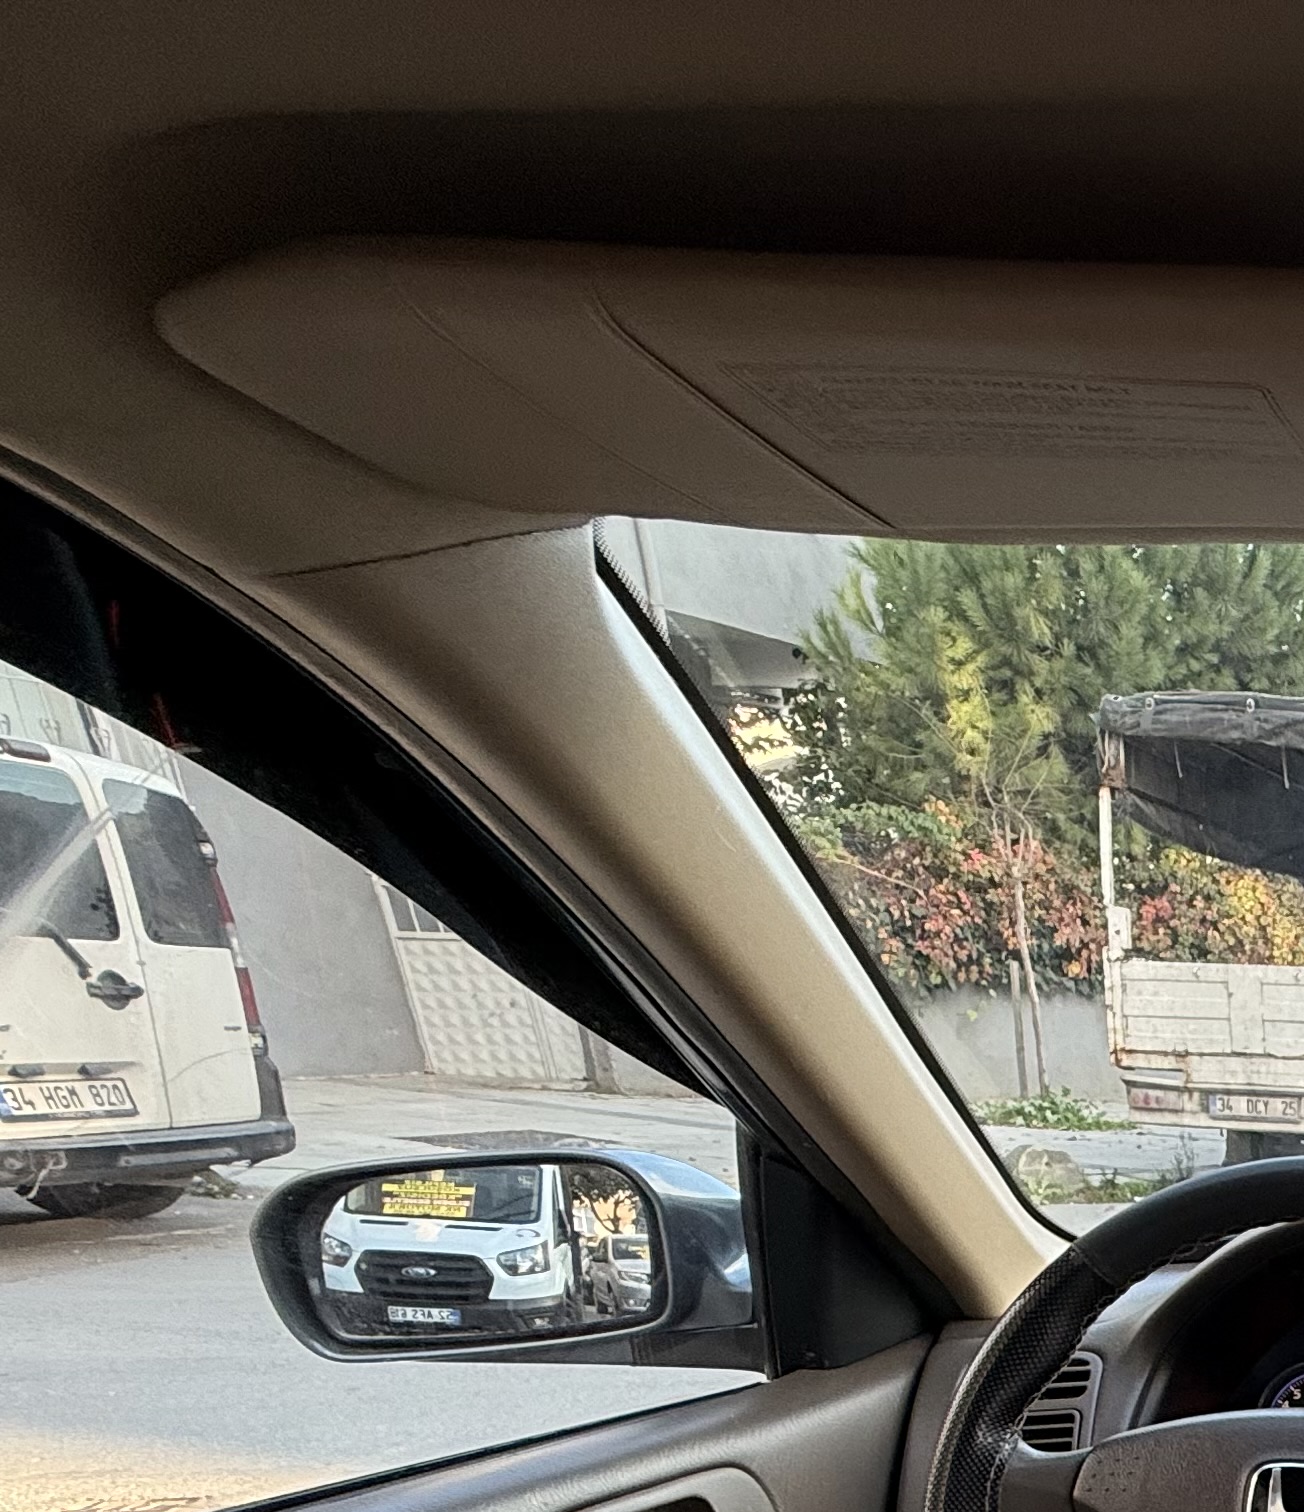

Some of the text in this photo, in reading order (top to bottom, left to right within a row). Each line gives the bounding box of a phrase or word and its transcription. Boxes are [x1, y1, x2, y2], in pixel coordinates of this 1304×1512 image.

[3, 1084, 126, 1110] 34 HGM 820
[1217, 1097, 1233, 1112] 34
[1281, 1101, 1296, 1116] 25
[1293, 1389, 1301, 1400] 5
